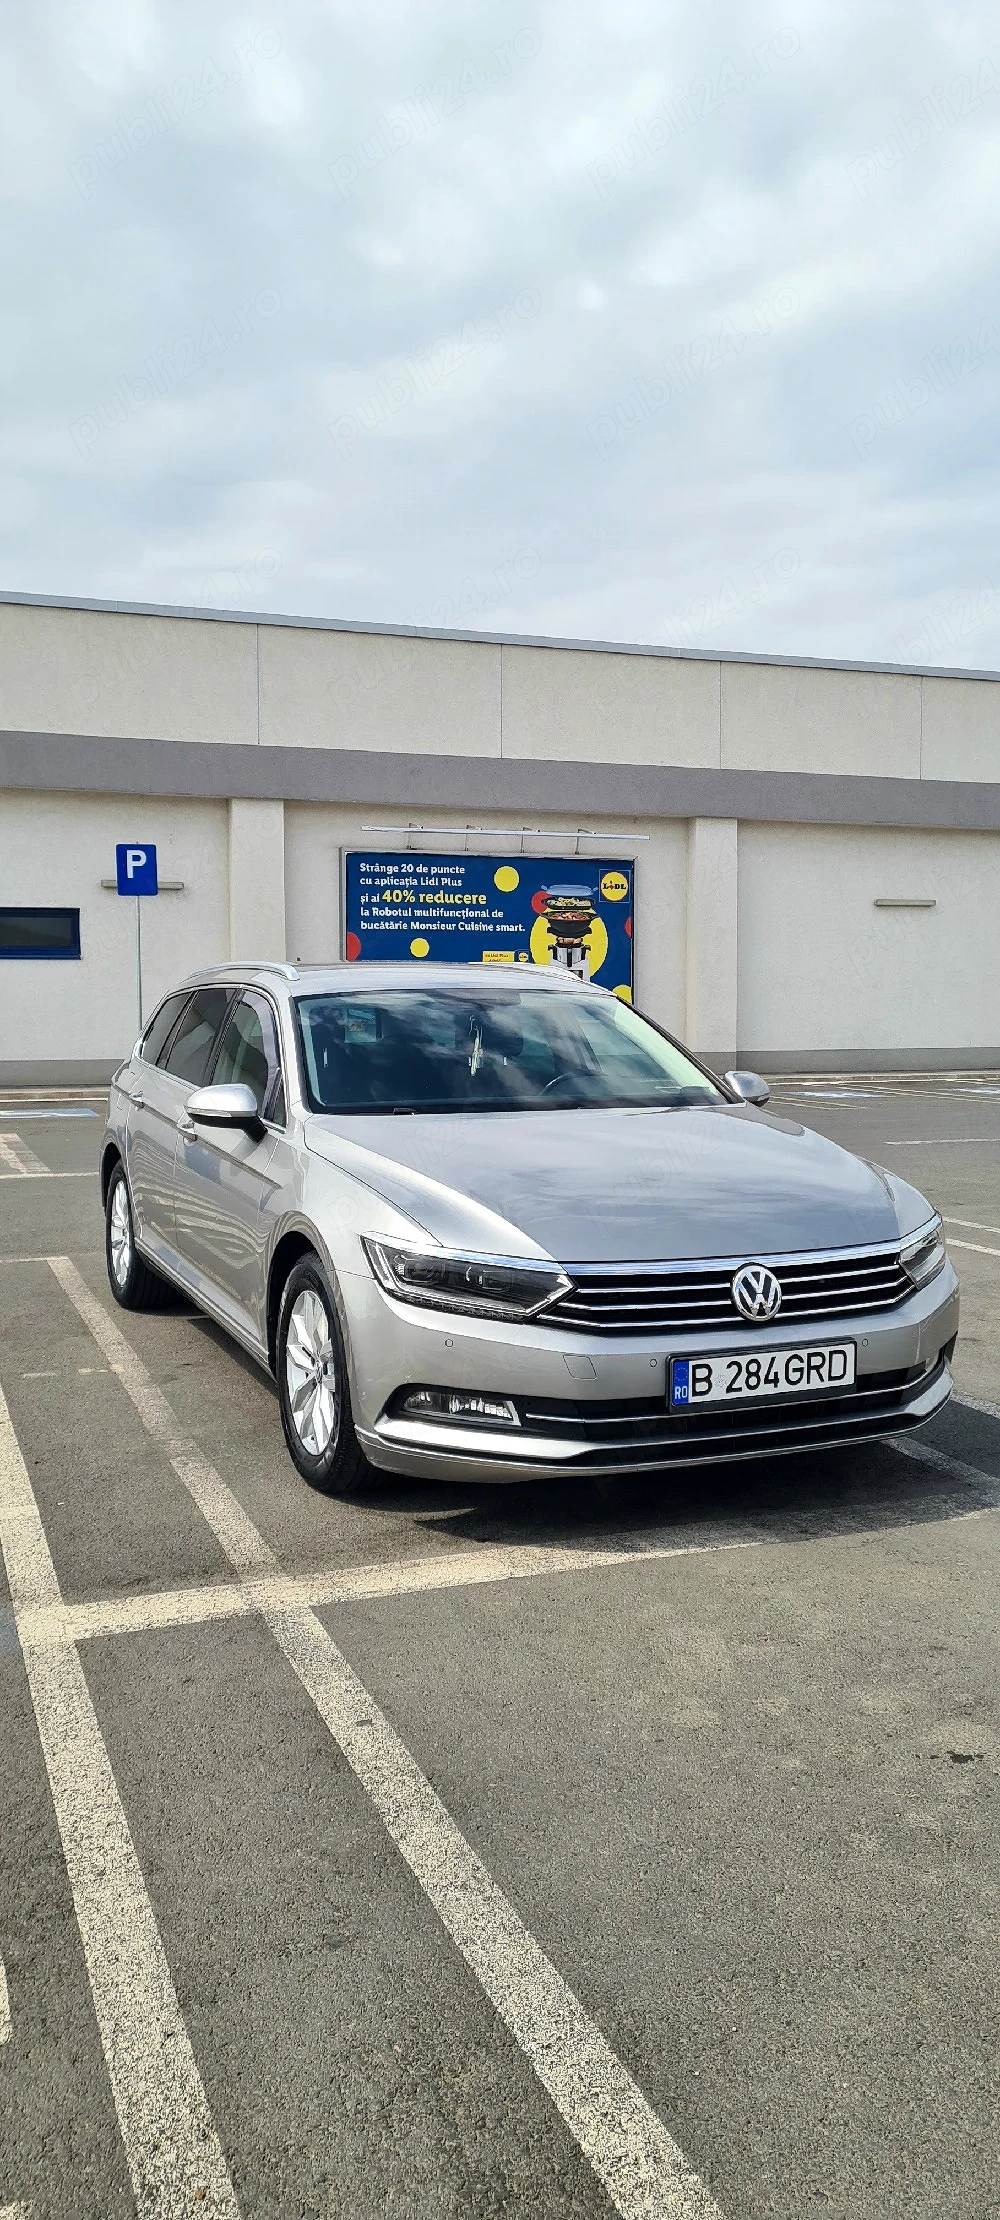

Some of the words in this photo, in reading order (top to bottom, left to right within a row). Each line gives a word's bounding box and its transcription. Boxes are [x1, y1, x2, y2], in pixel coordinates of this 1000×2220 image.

[126, 850, 147, 879] P
[360, 863, 399, 875] Strânge
[401, 864, 414, 873] 20
[416, 864, 428, 873] de
[431, 866, 466, 875] puncte
[421, 877, 439, 886] Lidl
[441, 878, 463, 887] Plus
[371, 894, 380, 903] ai
[382, 890, 416, 903] 40%
[419, 890, 487, 905] reducere
[360, 907, 370, 917] la
[372, 907, 412, 917] Robotul
[492, 910, 504, 918] de
[360, 921, 408, 930] bucătărie
[410, 921, 456, 930] Monsieur
[458, 922, 494, 931] Cuisine
[495, 923, 526, 932] smart.
[691, 1363, 713, 1398] B
[674, 1385, 688, 1400] RO
